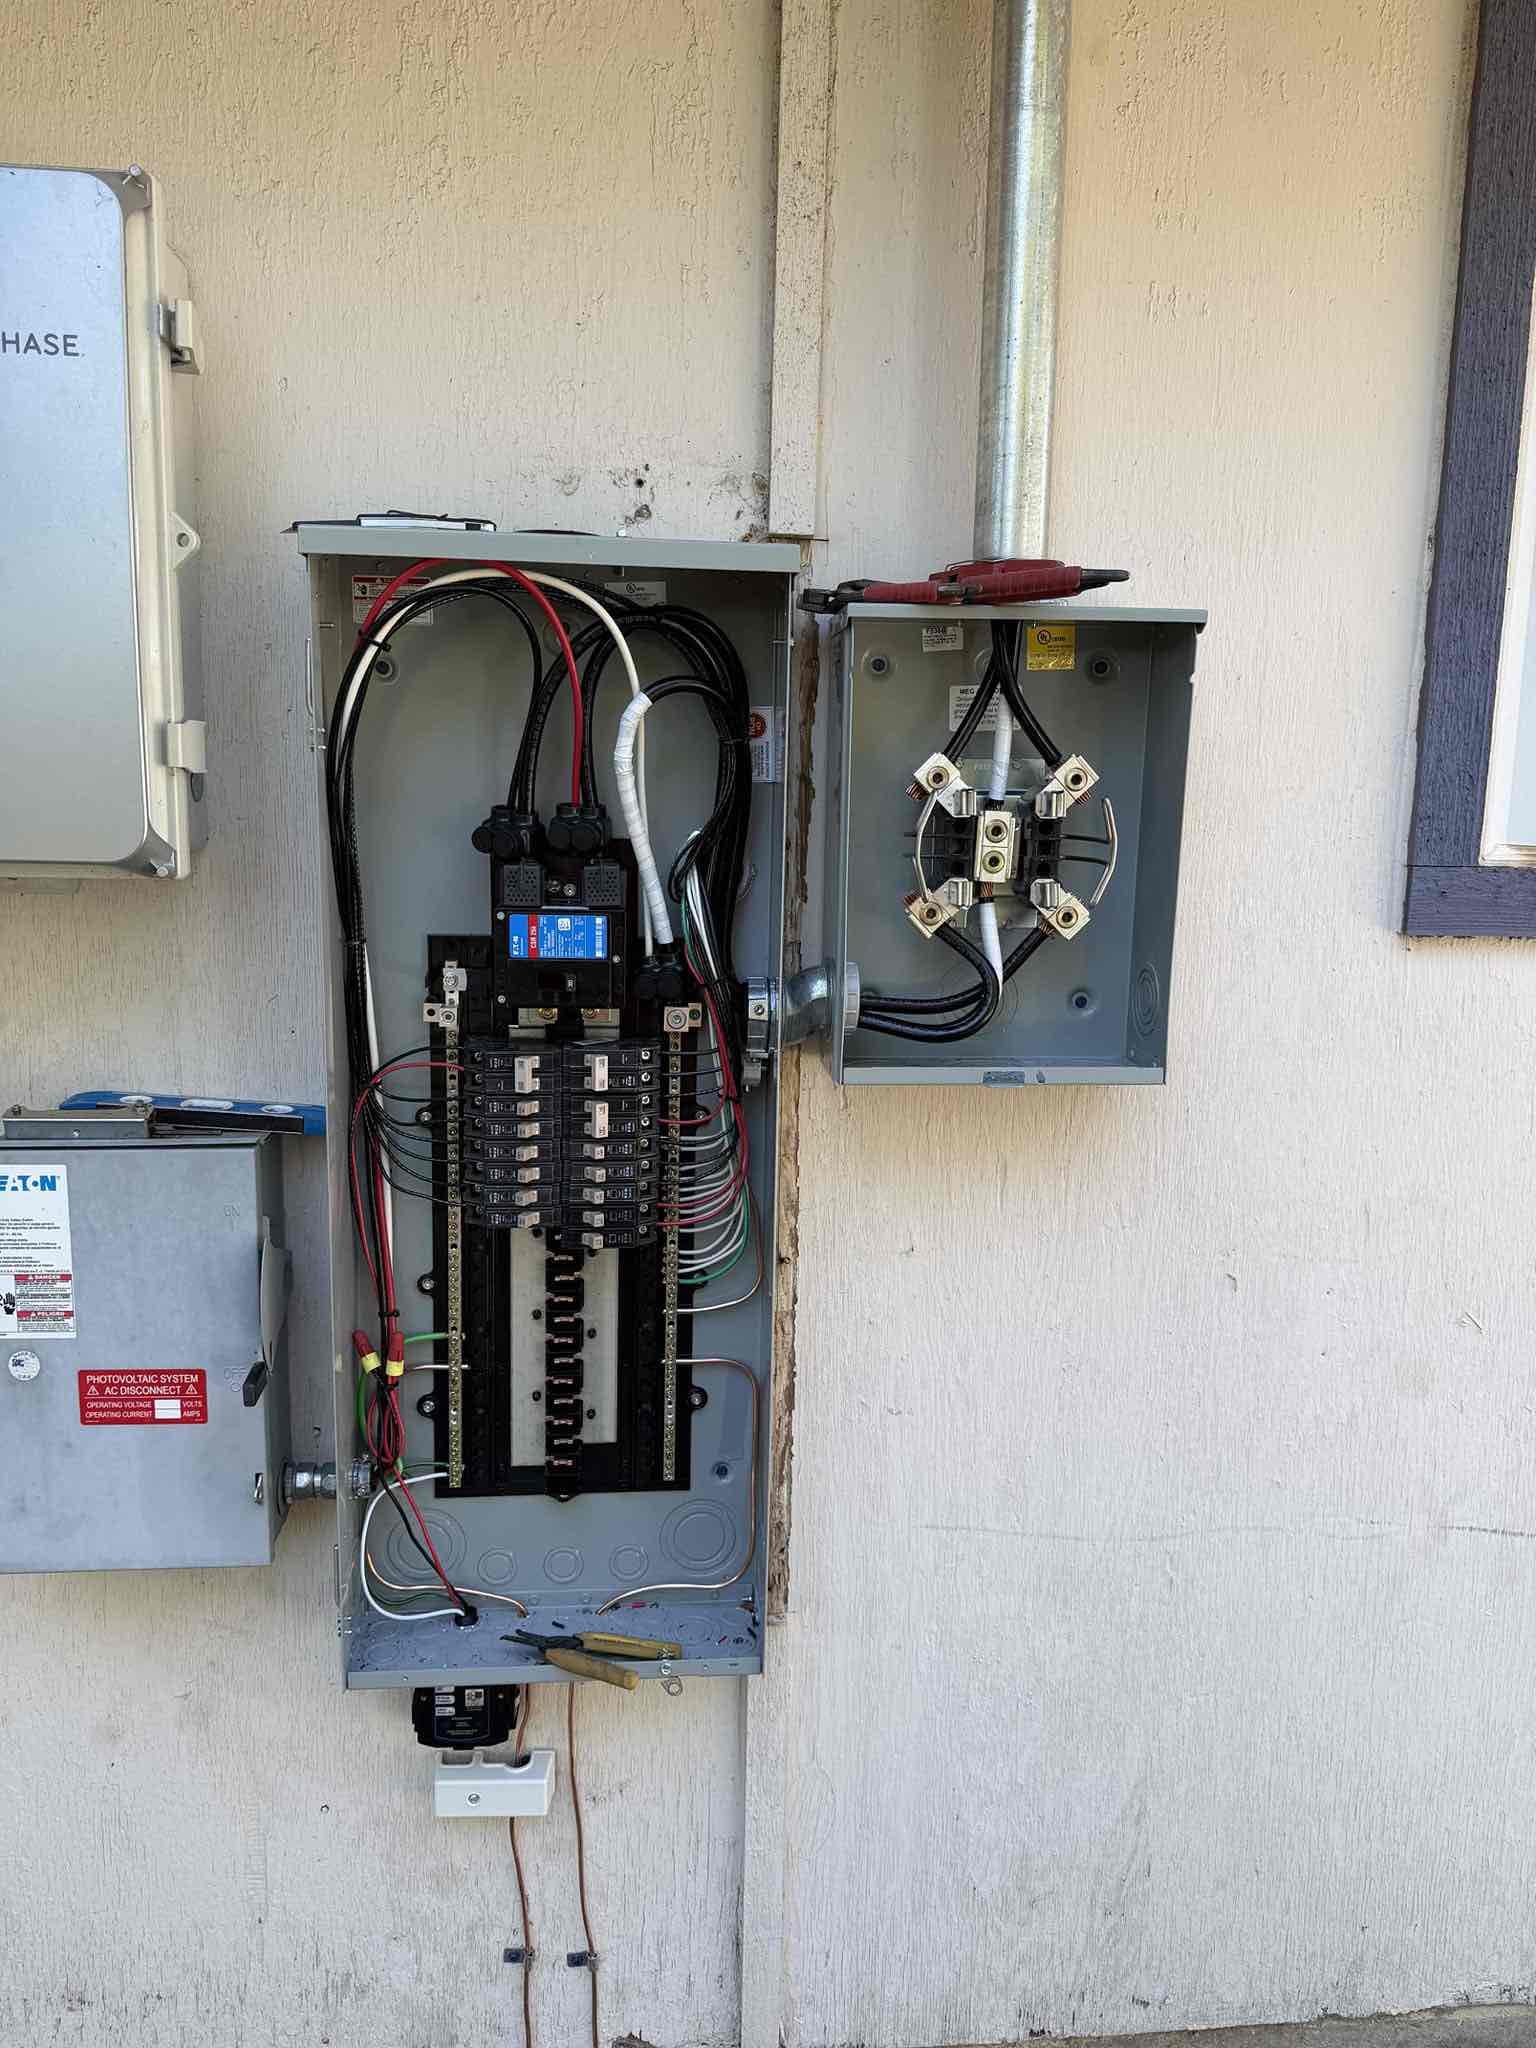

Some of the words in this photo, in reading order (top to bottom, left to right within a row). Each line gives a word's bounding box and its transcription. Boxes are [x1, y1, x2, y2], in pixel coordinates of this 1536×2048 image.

[0, 1175, 57, 1192] EATON
[86, 1374, 158, 1384] PHOTOVOLTAIC
[160, 1374, 199, 1383] SYSTEM
[104, 1386, 119, 1395] AC
[120, 1386, 181, 1395] DISCONNECT
[182, 1400, 203, 1408] VOLTS
[122, 1410, 152, 1418] CURRENT
